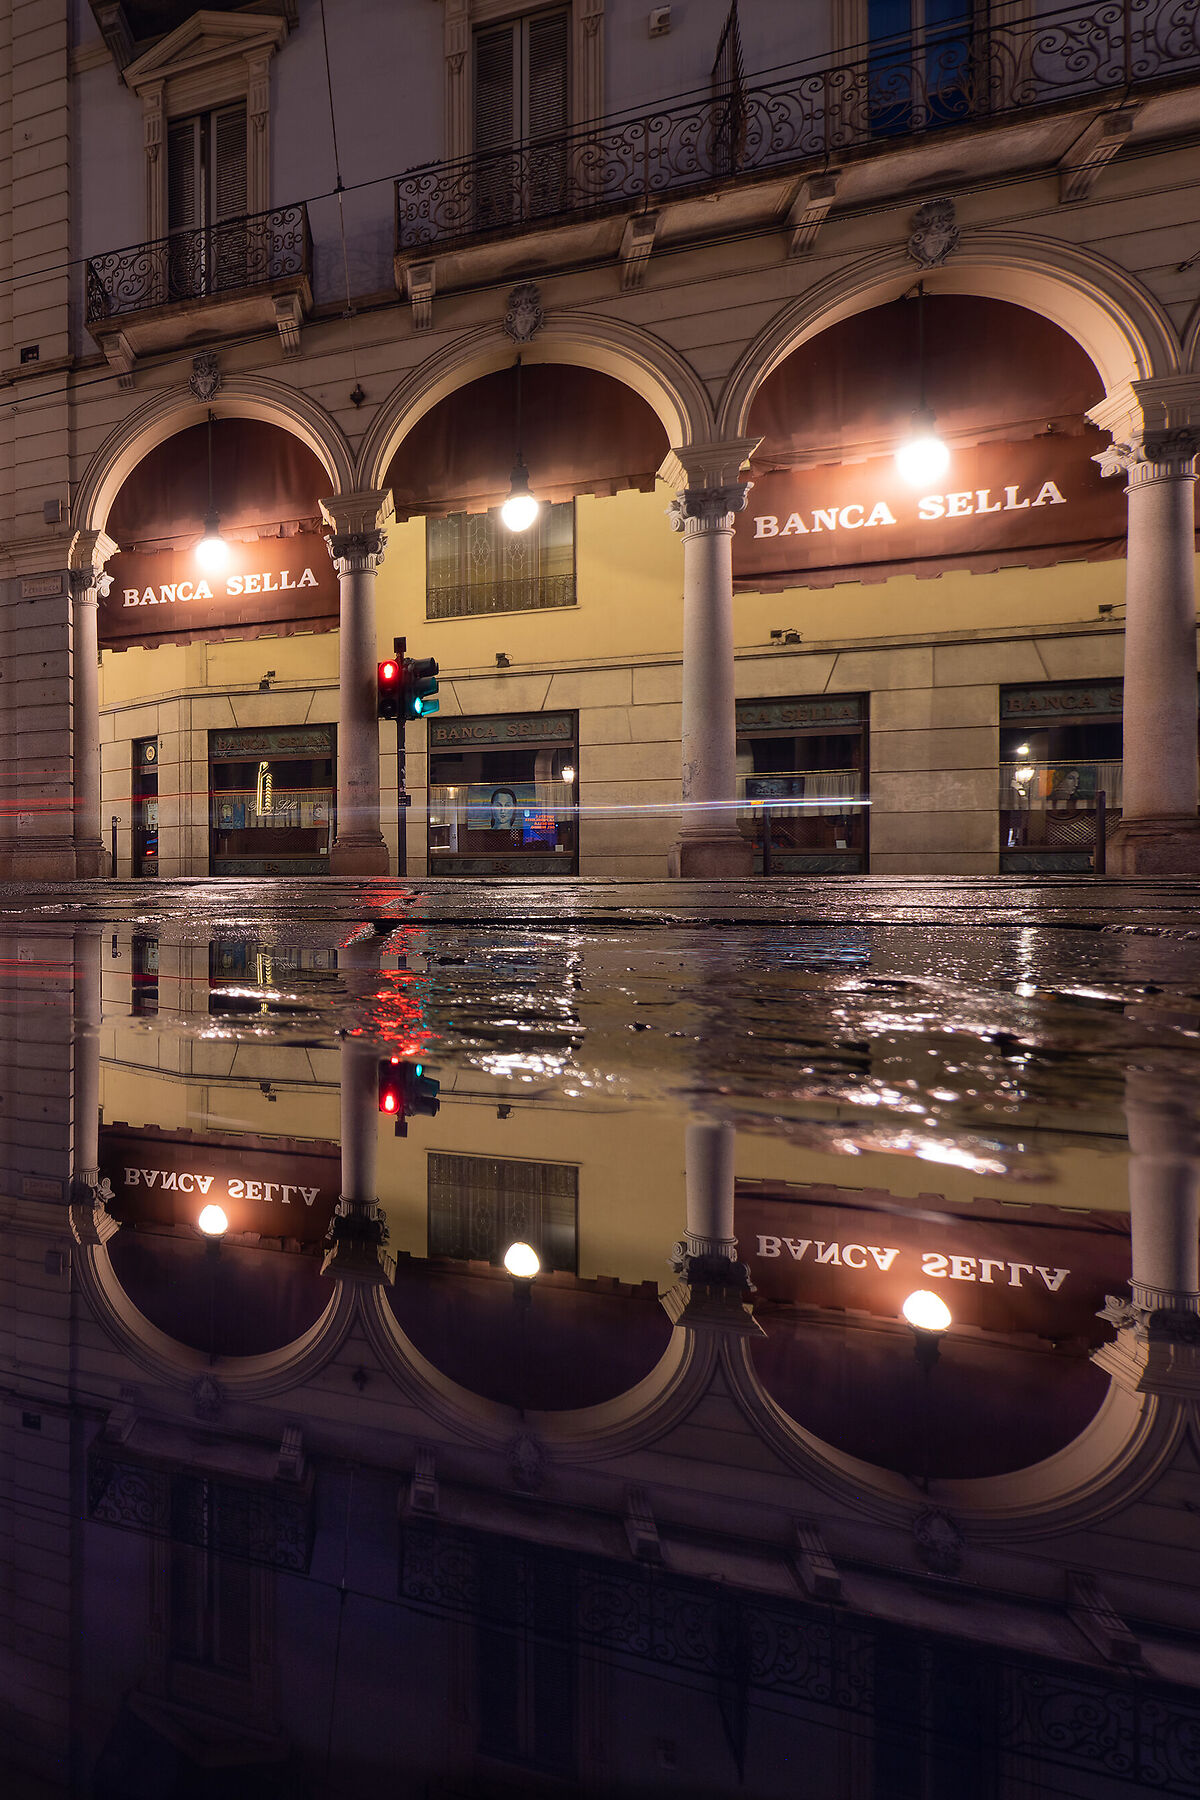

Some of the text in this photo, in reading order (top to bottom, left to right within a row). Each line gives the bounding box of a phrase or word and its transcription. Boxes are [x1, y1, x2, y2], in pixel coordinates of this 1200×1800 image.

[753, 481, 1066, 538] BANCA SELLA
[123, 568, 319, 607] BANCA SELLA
[1007, 696, 1096, 712] BANCA
[781, 706, 854, 722] SELLA
[436, 722, 568, 740] BANCA SELLA
[218, 735, 330, 751] BANCA SELLA
